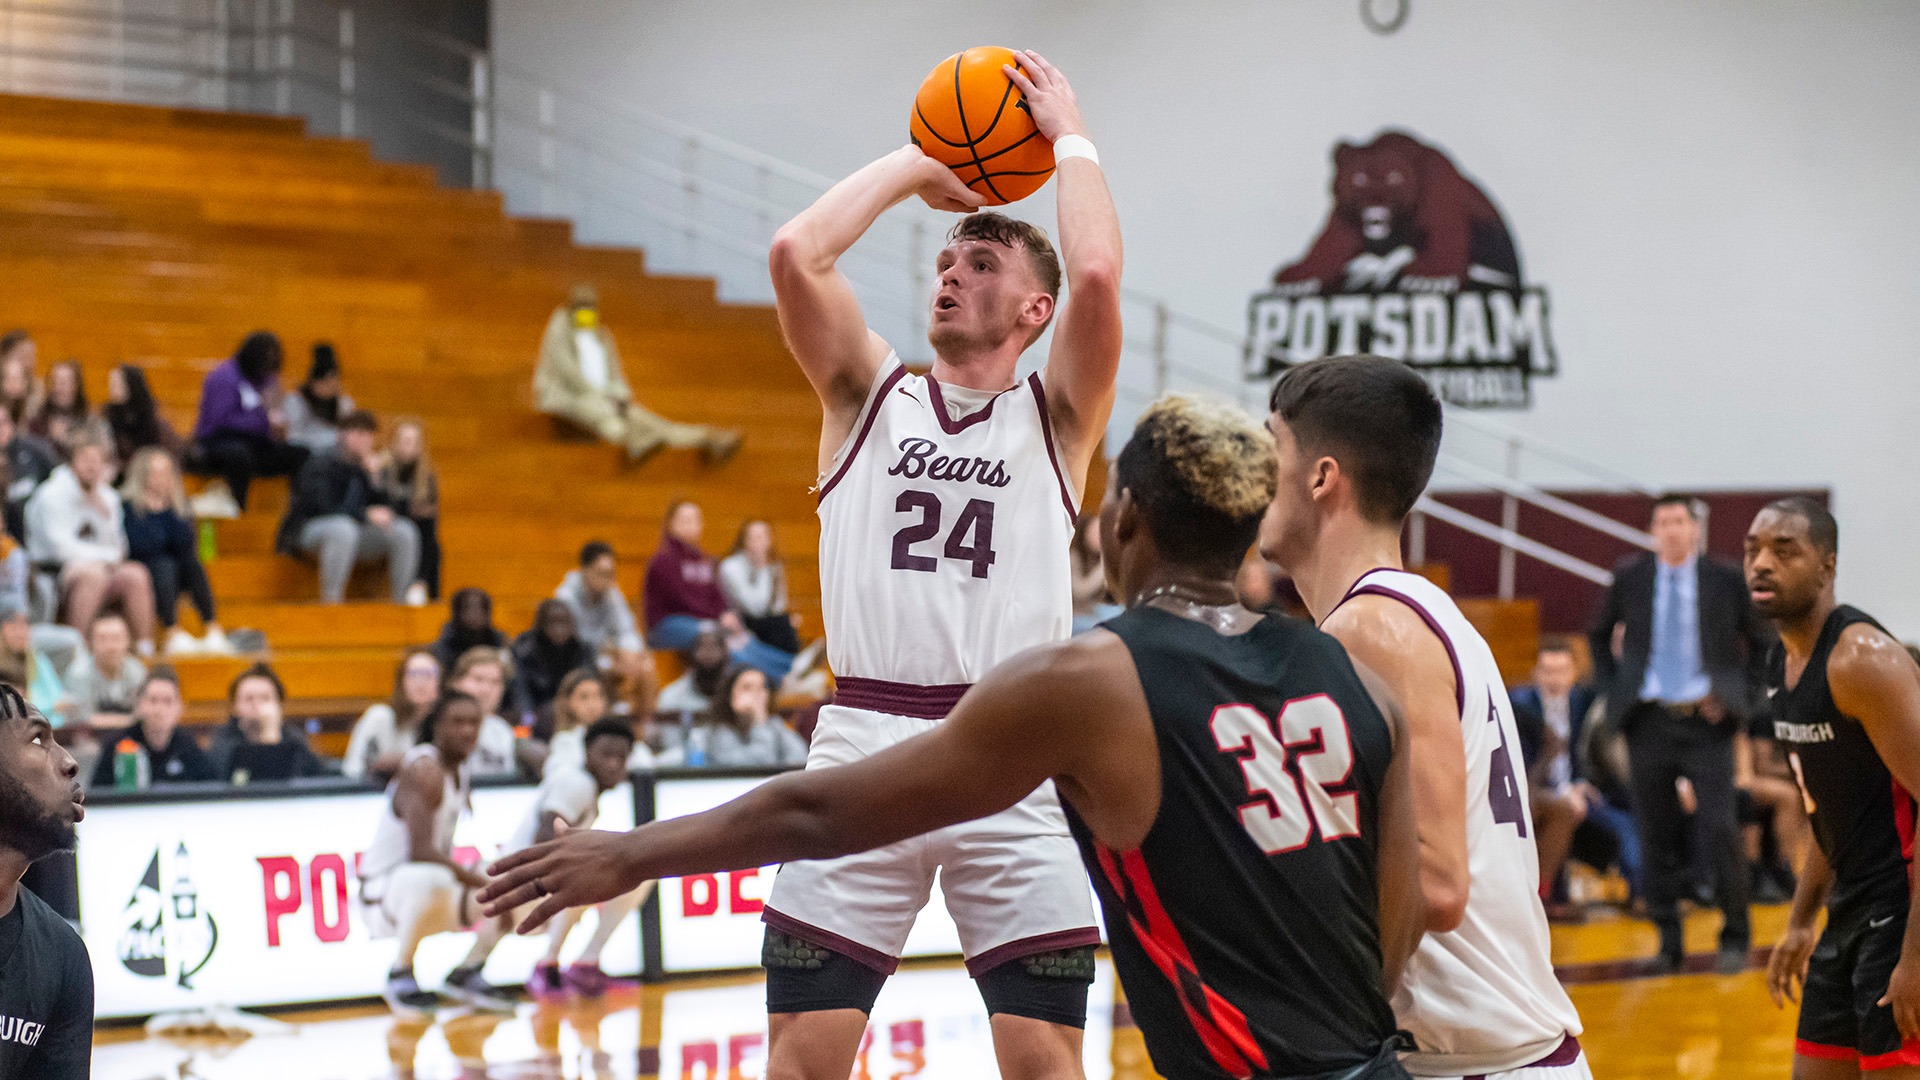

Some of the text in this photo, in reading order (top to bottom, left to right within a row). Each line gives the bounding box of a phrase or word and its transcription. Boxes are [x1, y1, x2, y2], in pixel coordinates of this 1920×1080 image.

[1247, 292, 1551, 377] POTSDAM
[887, 437, 1011, 487] Bears
[890, 489, 996, 579] 24
[1208, 692, 1361, 856] 32
